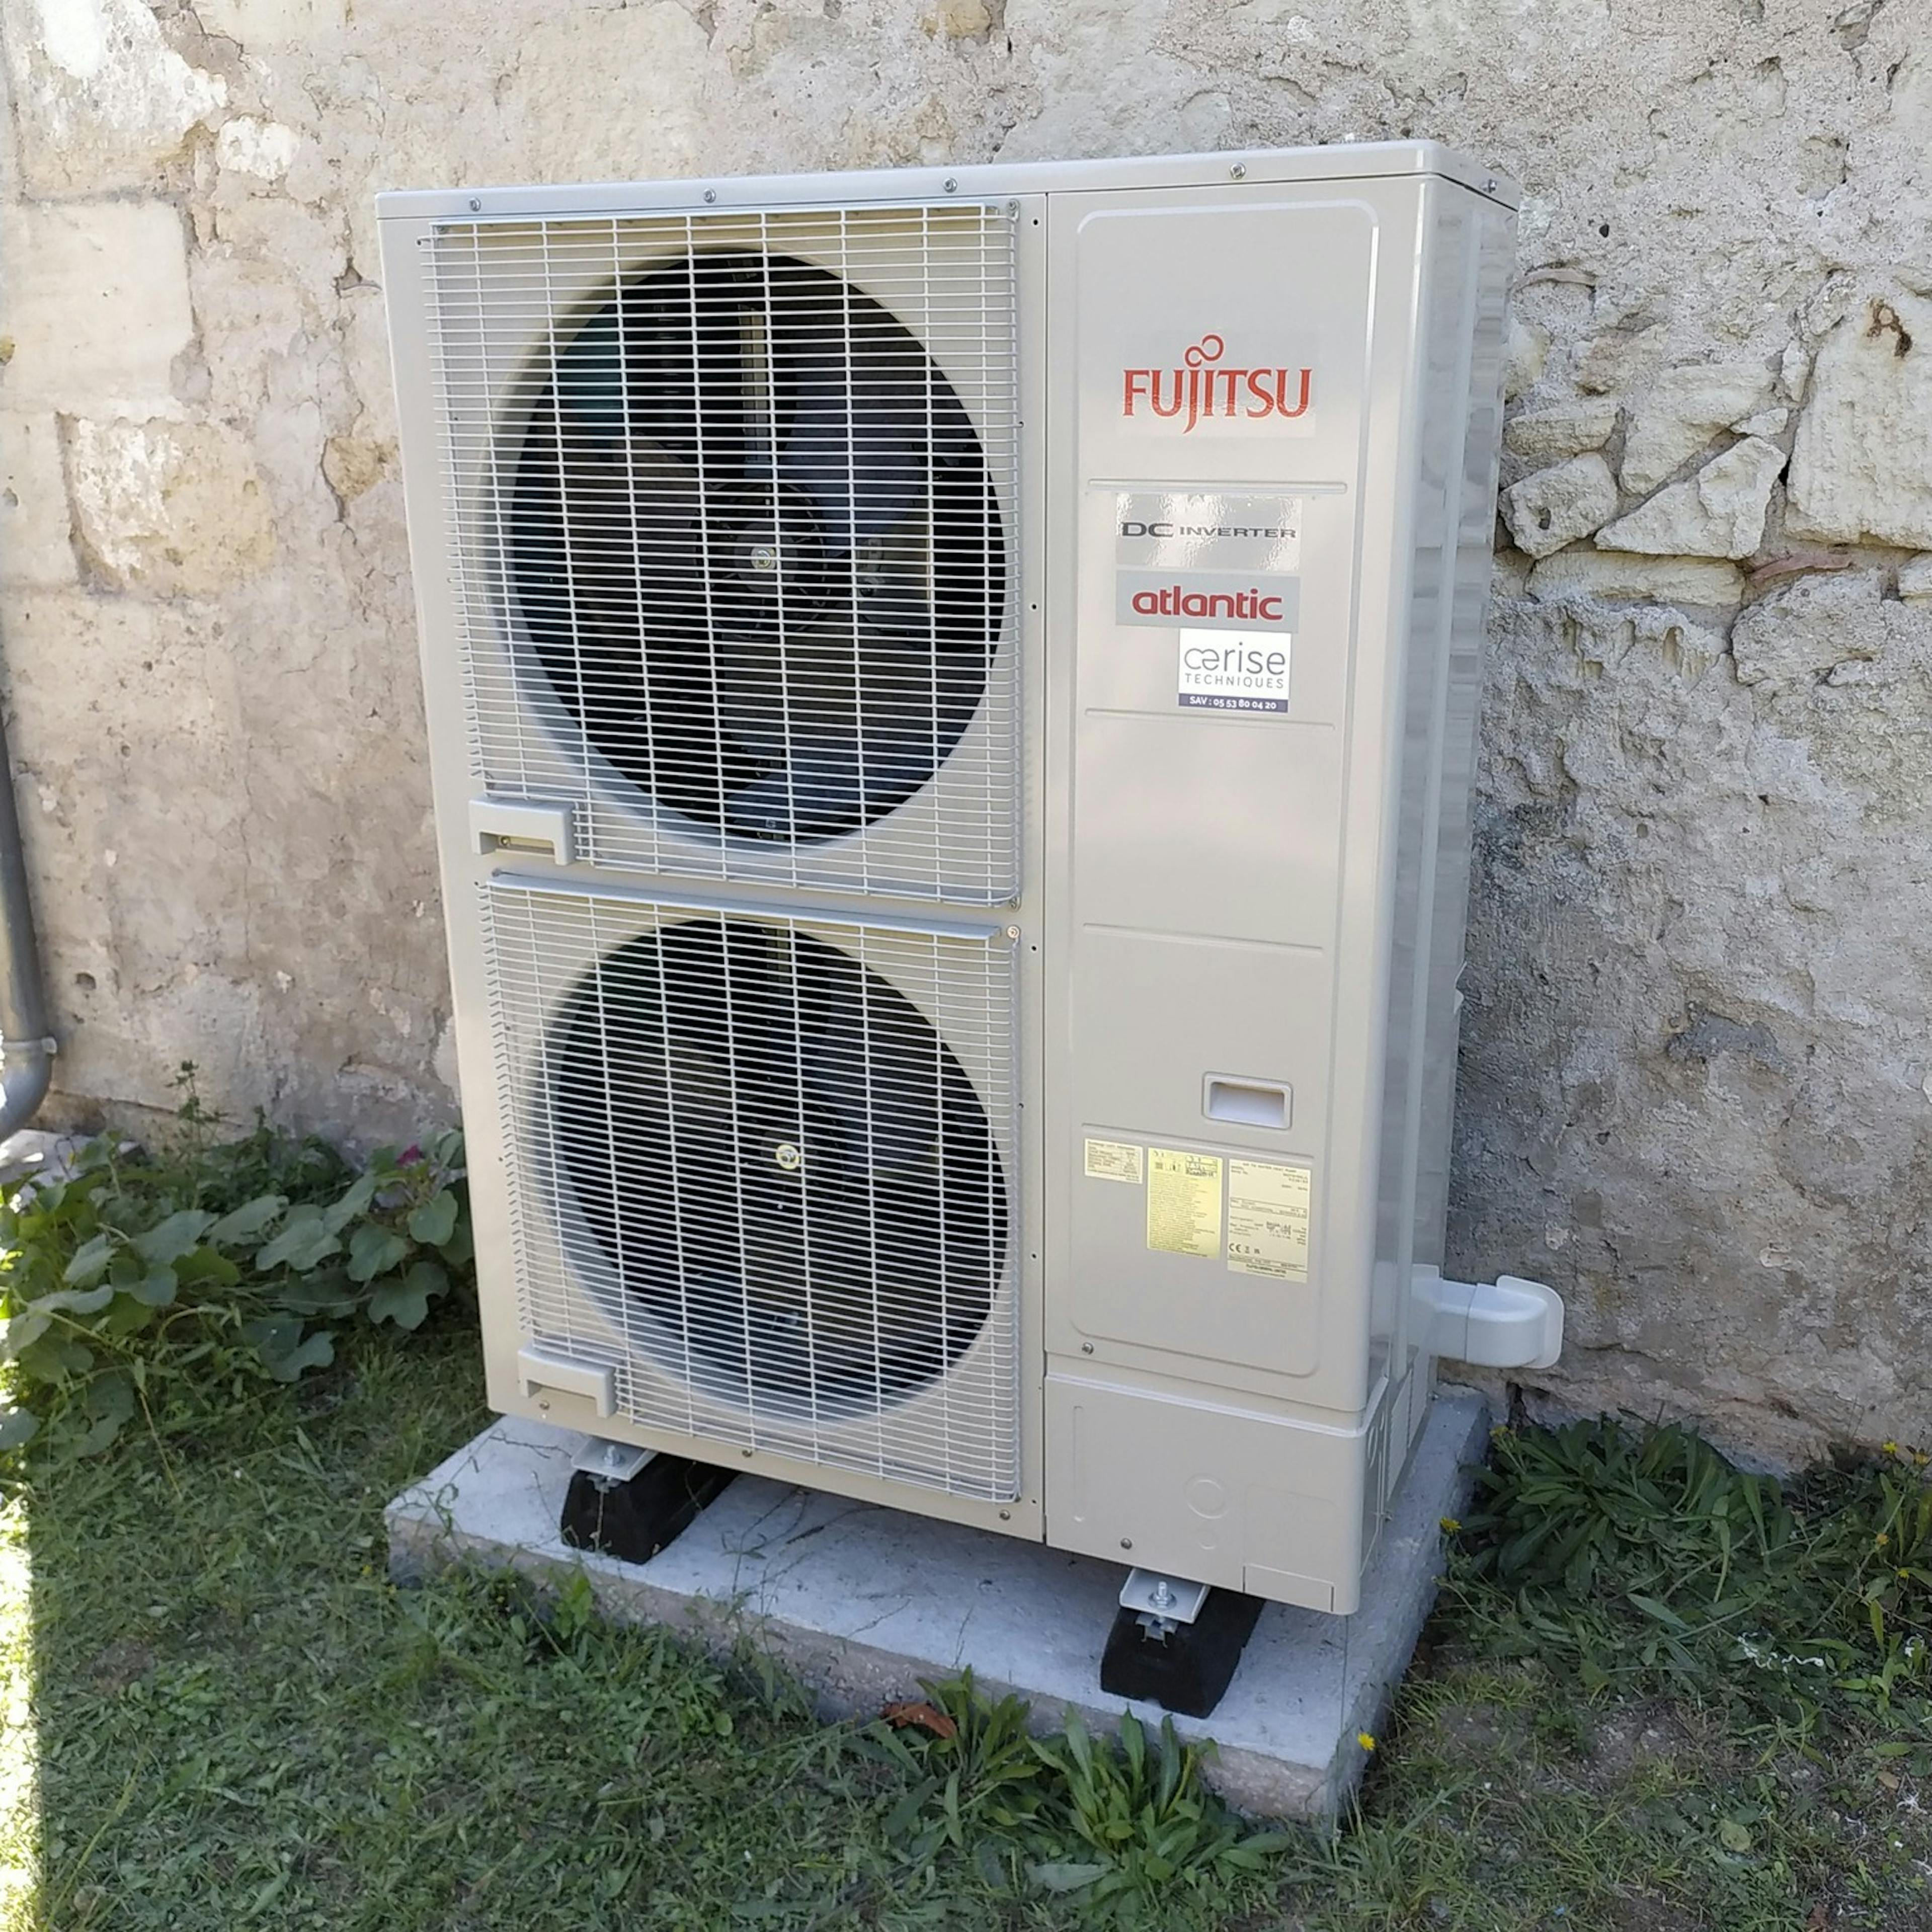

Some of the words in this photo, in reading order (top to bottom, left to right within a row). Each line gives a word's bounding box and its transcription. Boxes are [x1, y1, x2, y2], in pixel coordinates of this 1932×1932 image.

[1122, 368, 1312, 434] FUJITSU
[1122, 522, 1173, 537] DC
[1180, 526, 1297, 538] INVERTER
[1132, 586, 1283, 620] atlantic
[1185, 673, 1284, 689] TECHNIQUES
[1213, 698, 1225, 708] 05
[1226, 699, 1237, 708] 53
[1251, 700, 1263, 709] 04
[1264, 701, 1276, 709] 20
